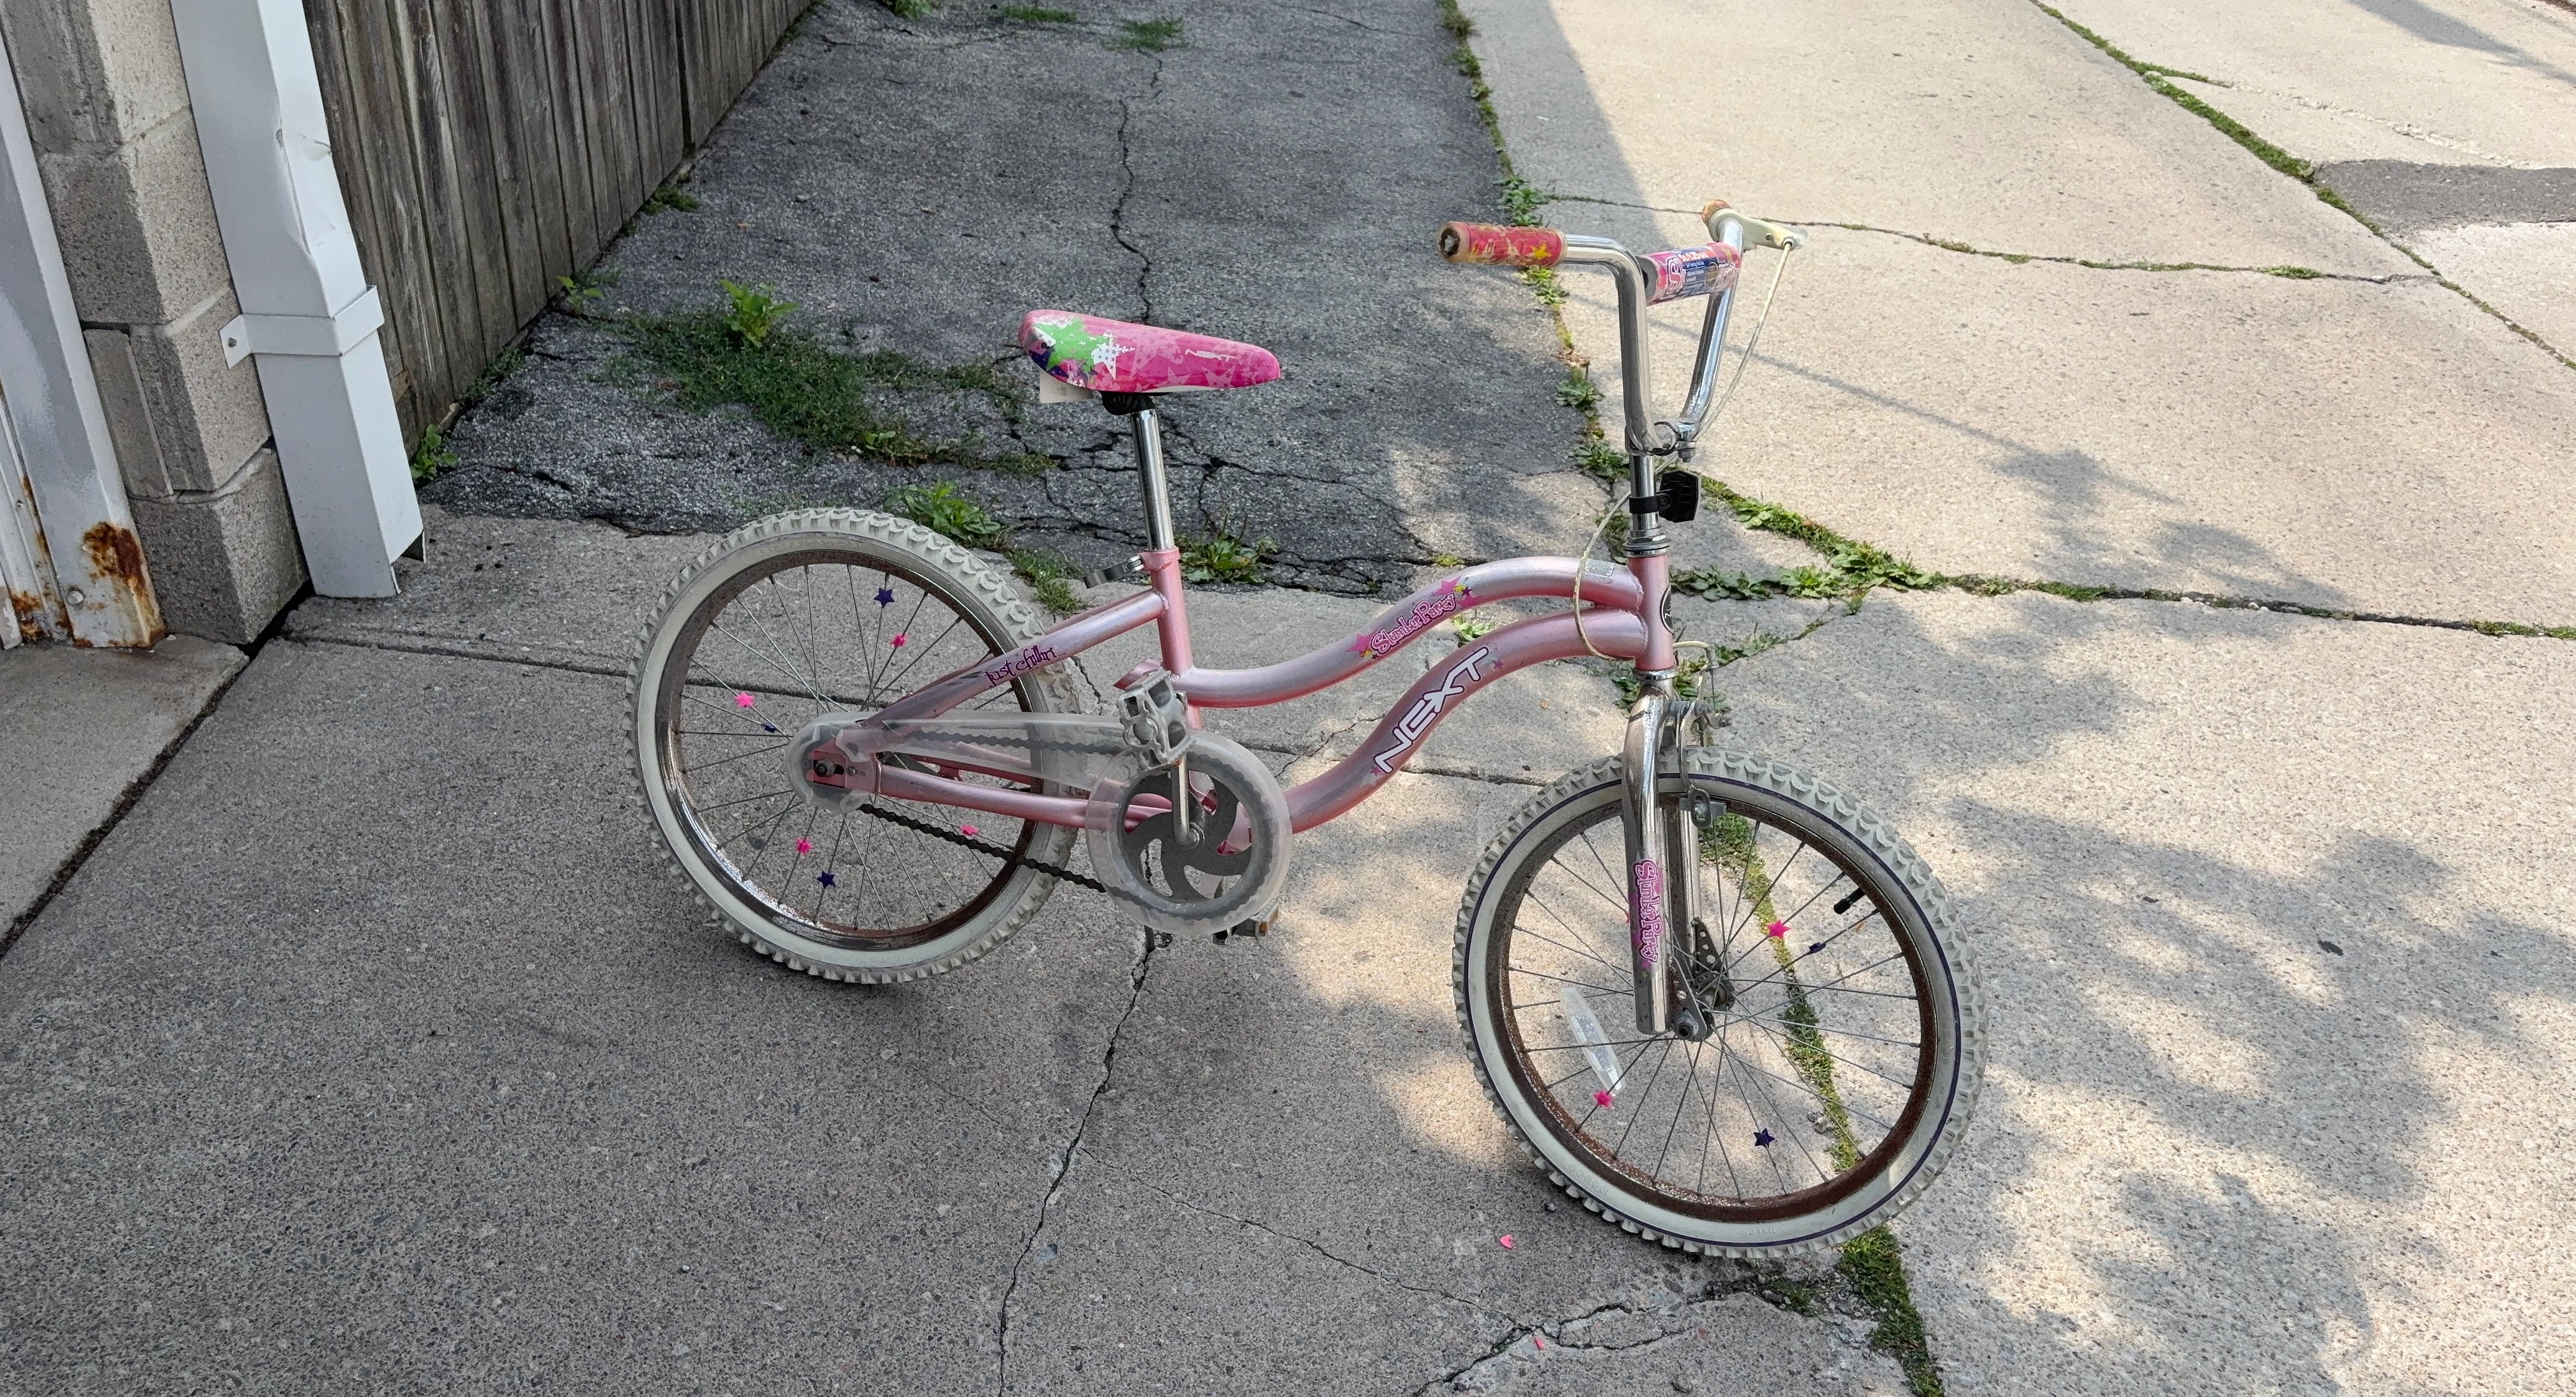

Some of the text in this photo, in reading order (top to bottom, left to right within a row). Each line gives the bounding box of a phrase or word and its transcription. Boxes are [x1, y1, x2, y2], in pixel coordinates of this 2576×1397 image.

[1184, 348, 1236, 362] NEXT
[1370, 592, 1456, 654] Slumber Party
[1374, 647, 1489, 774] NEXT
[1632, 860, 1664, 963] Slumber Party
